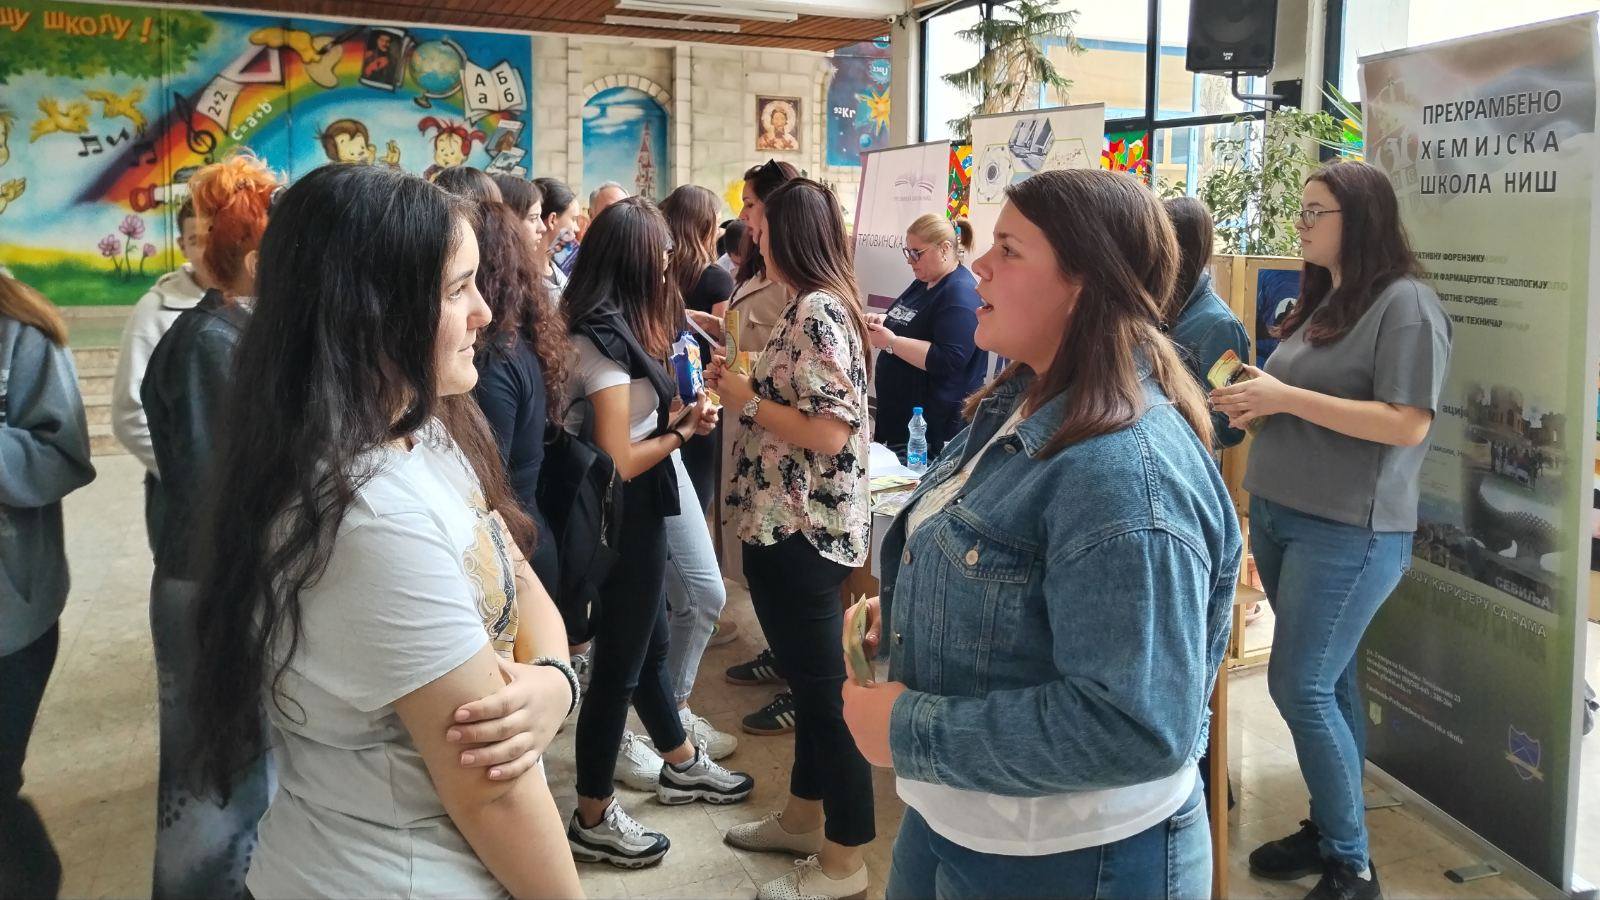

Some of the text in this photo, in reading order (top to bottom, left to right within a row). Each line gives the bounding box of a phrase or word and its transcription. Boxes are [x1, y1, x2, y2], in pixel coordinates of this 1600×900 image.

[496, 71, 508, 85] Б
[208, 90, 228, 117] 2+2
[1422, 89, 1562, 125] ПРЕХРАМБЕНО
[1420, 130, 1560, 160] ХЕМИЈСКА
[1420, 170, 1557, 195] ШКОЛА НИШ
[1442, 253, 1485, 263] ФОРЕНЗИКУ
[1439, 273, 1495, 285] ФАРМАЦЕУТСКУ
[1497, 277, 1548, 290] ТЕХНОЛОГИЈУ
[1464, 295, 1498, 306] СРЕДИНЕ
[1466, 315, 1503, 328] ТЕХНИЧАР
